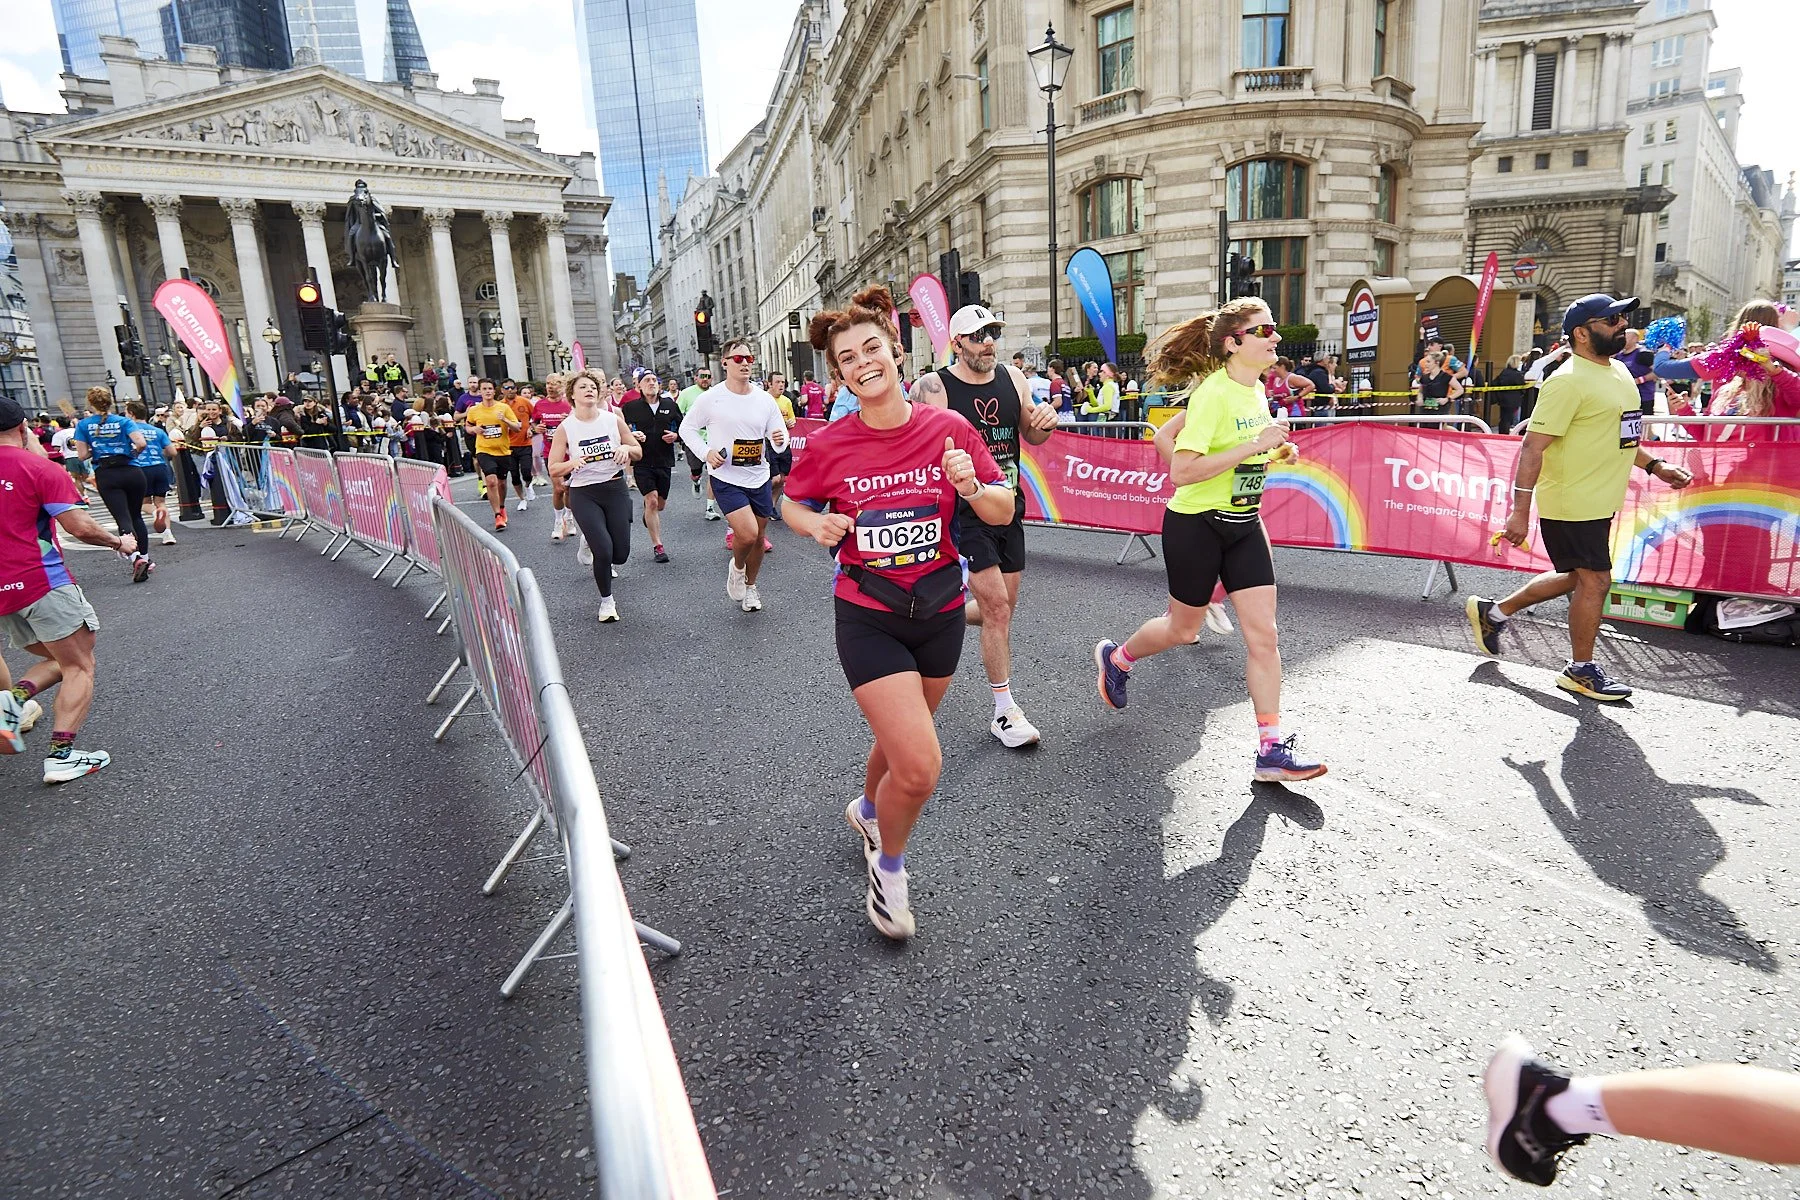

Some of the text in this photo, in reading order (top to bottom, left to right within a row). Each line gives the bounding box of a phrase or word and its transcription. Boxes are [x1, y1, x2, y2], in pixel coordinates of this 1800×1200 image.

[1350, 311, 1377, 324] UNDERGROUND
[1348, 350, 1376, 360] BANK STATION
[581, 442, 611, 455] 10864
[738, 446, 760, 455] 2965
[988, 442, 1009, 453] arity
[843, 463, 942, 494] Tommy's
[905, 487, 922, 495] baby
[923, 487, 942, 495] charity
[1062, 485, 1074, 496] The
[1075, 487, 1112, 503] pregnancy
[1113, 492, 1127, 502] and
[1129, 493, 1150, 505] baby
[885, 510, 914, 520] MEGAN
[1384, 500, 1404, 511] The
[1406, 503, 1465, 519] pregnancy
[1468, 511, 1489, 523] and
[863, 522, 937, 549] 10628
